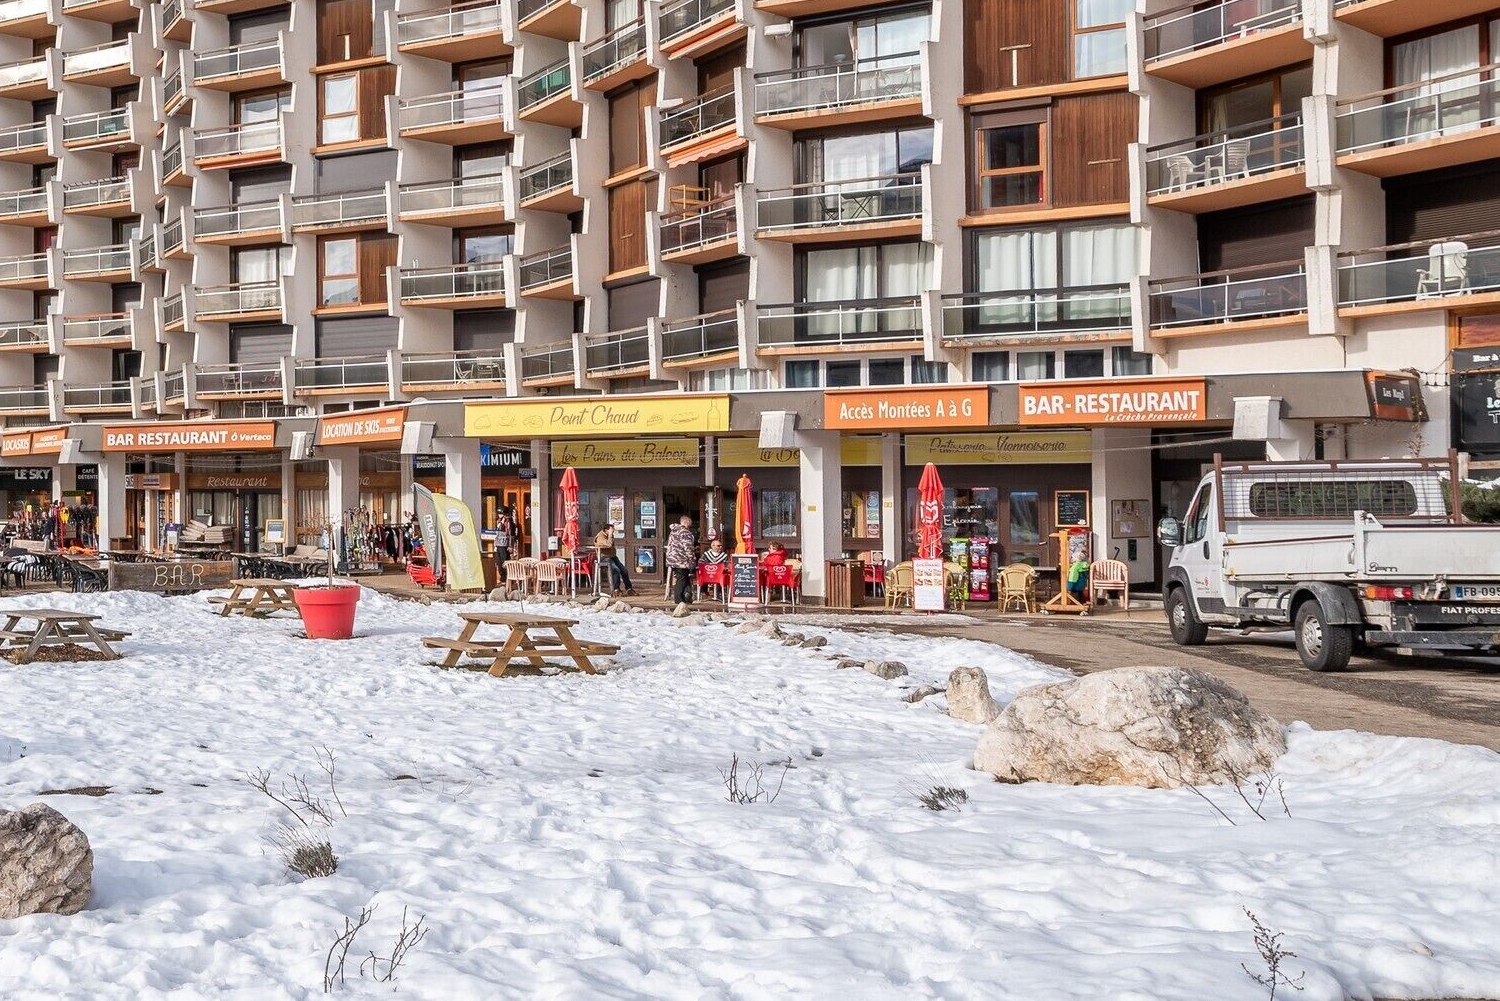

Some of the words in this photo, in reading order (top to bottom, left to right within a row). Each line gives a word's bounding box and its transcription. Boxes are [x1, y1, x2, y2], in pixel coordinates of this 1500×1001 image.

[550, 406, 589, 426] Point
[591, 404, 640, 425] Chaud
[839, 402, 874, 419] Accès
[878, 400, 931, 418] Montées
[935, 399, 945, 417] A
[949, 400, 957, 417] à
[961, 398, 972, 417] G
[323, 422, 353, 439] LOCATION
[353, 421, 363, 436] DE
[364, 419, 380, 434] SKIS
[107, 433, 134, 446] BAR
[137, 431, 228, 445] RESTAURANT
[997, 435, 1067, 452] Viennoiserie
[480, 452, 520, 466] KIMIUM
[561, 445, 577, 464] Les
[583, 444, 616, 462] Pains
[776, 448, 800, 462] Bo
[14, 469, 28, 480] LE
[29, 468, 50, 480] SKY
[207, 475, 268, 487] Restaurant
[153, 564, 205, 587] BAR
[1441, 606, 1463, 614] FIAT
